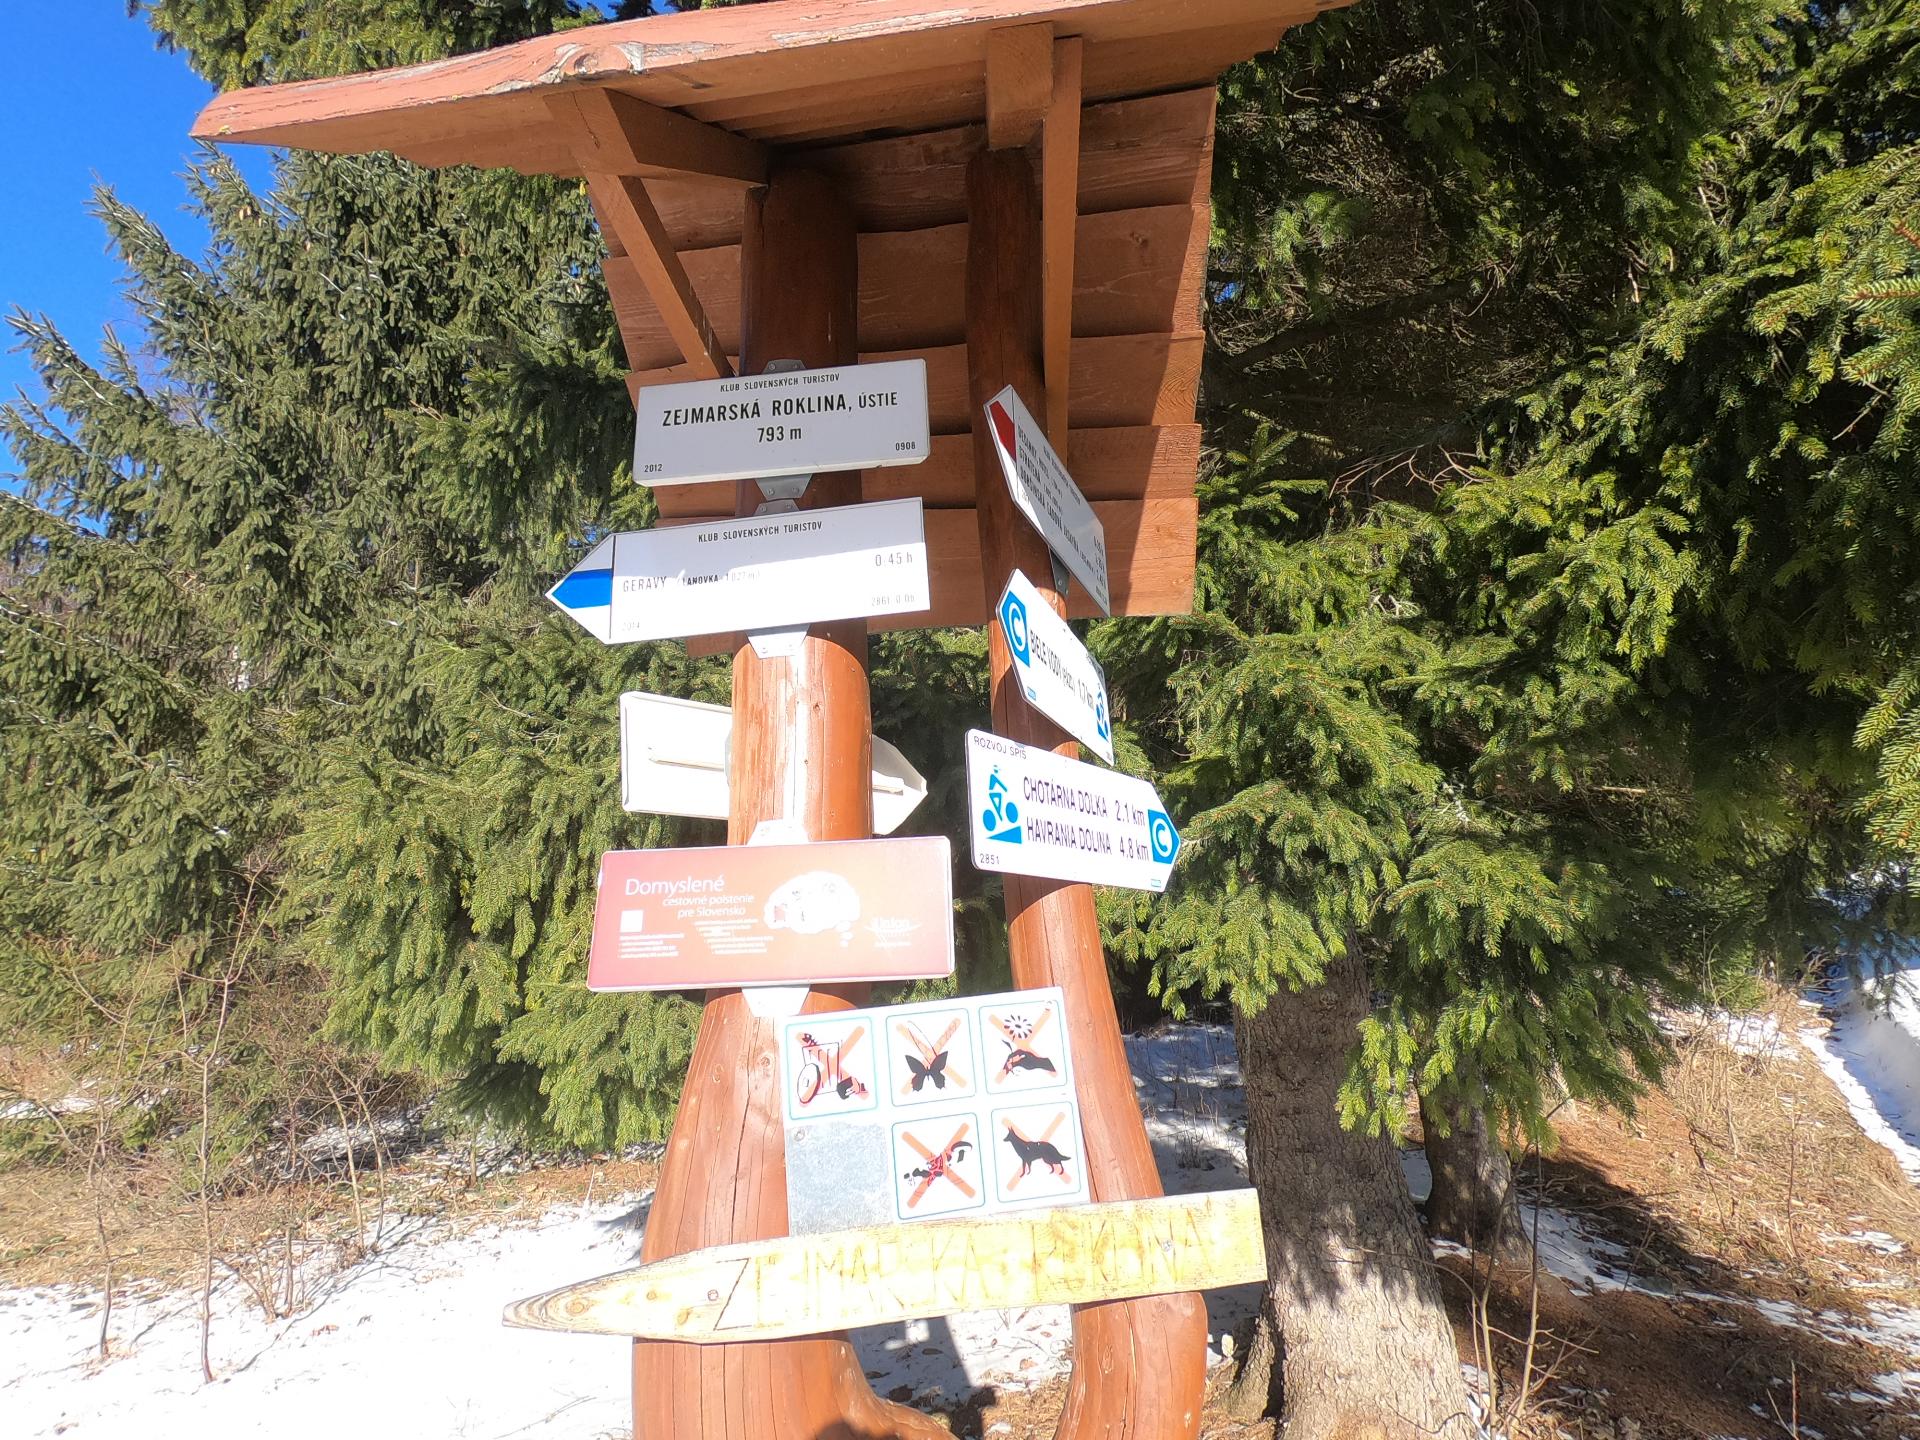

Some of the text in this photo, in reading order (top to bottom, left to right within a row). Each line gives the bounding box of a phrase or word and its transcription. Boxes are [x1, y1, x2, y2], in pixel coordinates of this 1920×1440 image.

[720, 383, 740, 393] KLUB
[803, 373, 840, 385] TURISTOV
[662, 391, 898, 427] ZEJMARSKÁ ROKLINA, ÚSTIE
[757, 426, 802, 443] 793 m
[895, 441, 916, 451] 0908
[643, 463, 663, 473] 2012
[698, 532, 719, 543] KLUB
[783, 520, 822, 533] TURISTOV
[622, 575, 667, 592] GERAVY
[973, 735, 1007, 754] ROZVOJ
[1023, 776, 1077, 812] CHOTÁRNA
[1078, 790, 1108, 818] DOLKA
[1131, 803, 1146, 827] km
[1026, 816, 1078, 849] HAVRANIA
[1078, 826, 1113, 855] DOLINA
[1135, 839, 1150, 862] km
[979, 853, 1000, 865] 2851
[624, 874, 725, 899] Domyslené
[697, 903, 746, 918] Slovensko
